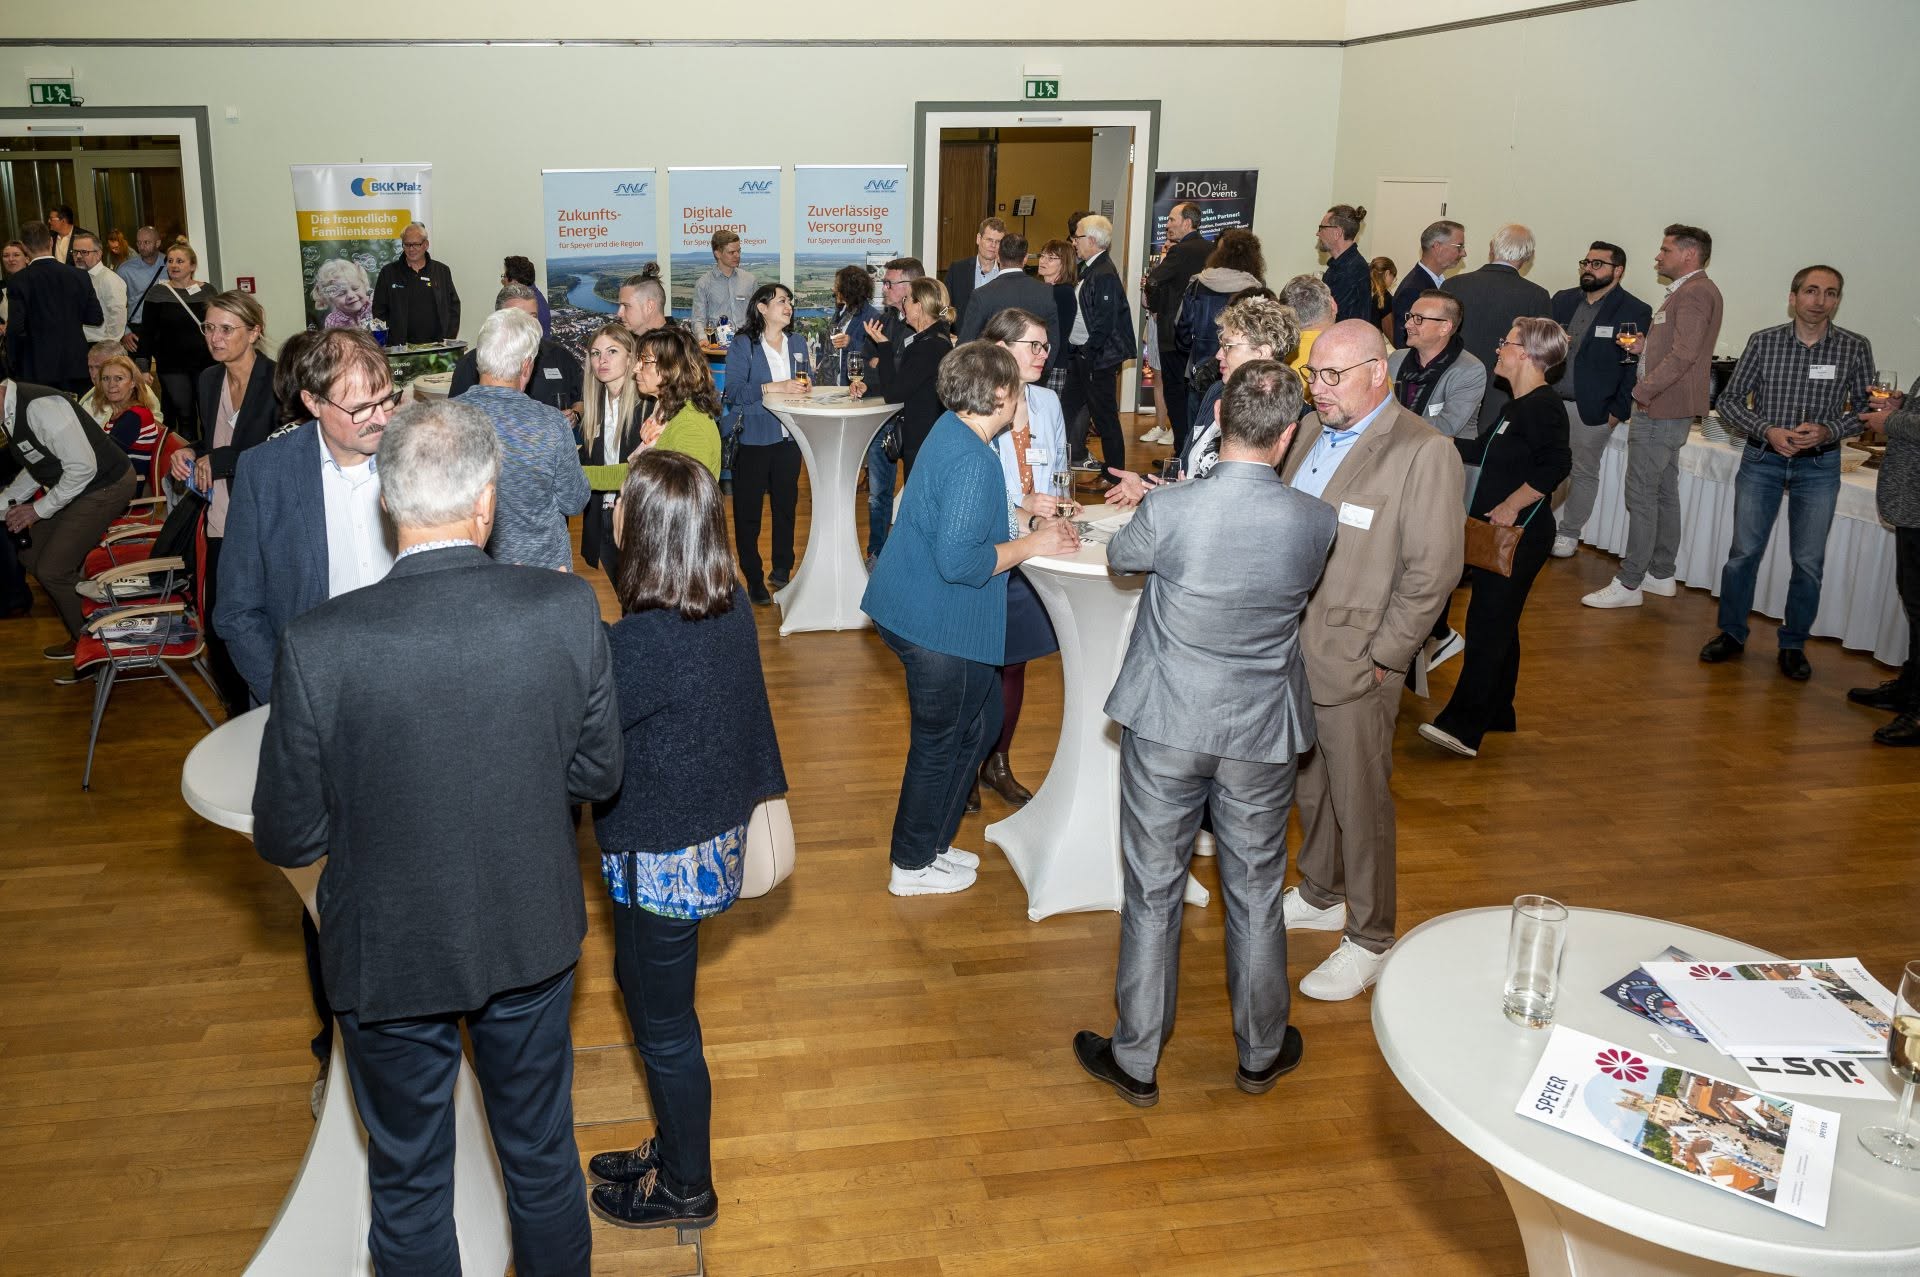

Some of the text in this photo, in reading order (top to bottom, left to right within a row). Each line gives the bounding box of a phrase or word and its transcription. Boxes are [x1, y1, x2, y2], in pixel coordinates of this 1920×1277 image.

[371, 182, 422, 192] BKK Pfalz
[558, 208, 622, 221] Zukunfts-
[683, 206, 733, 221] Digitale
[807, 204, 889, 220] Zuverlässige
[1217, 211, 1240, 220] Partner!
[311, 213, 398, 225] Die freundliche
[311, 225, 393, 237] Familienkasse
[559, 225, 608, 240] Energie
[807, 221, 883, 236] Versorgung
[559, 241, 569, 249] für
[570, 241, 593, 250] Speyer
[620, 240, 644, 249] Region
[694, 239, 712, 247] Spey
[743, 239, 767, 247] Region
[818, 237, 840, 246] Speyer
[867, 237, 891, 246] Region
[1535, 1075, 1569, 1114] SPEYER
